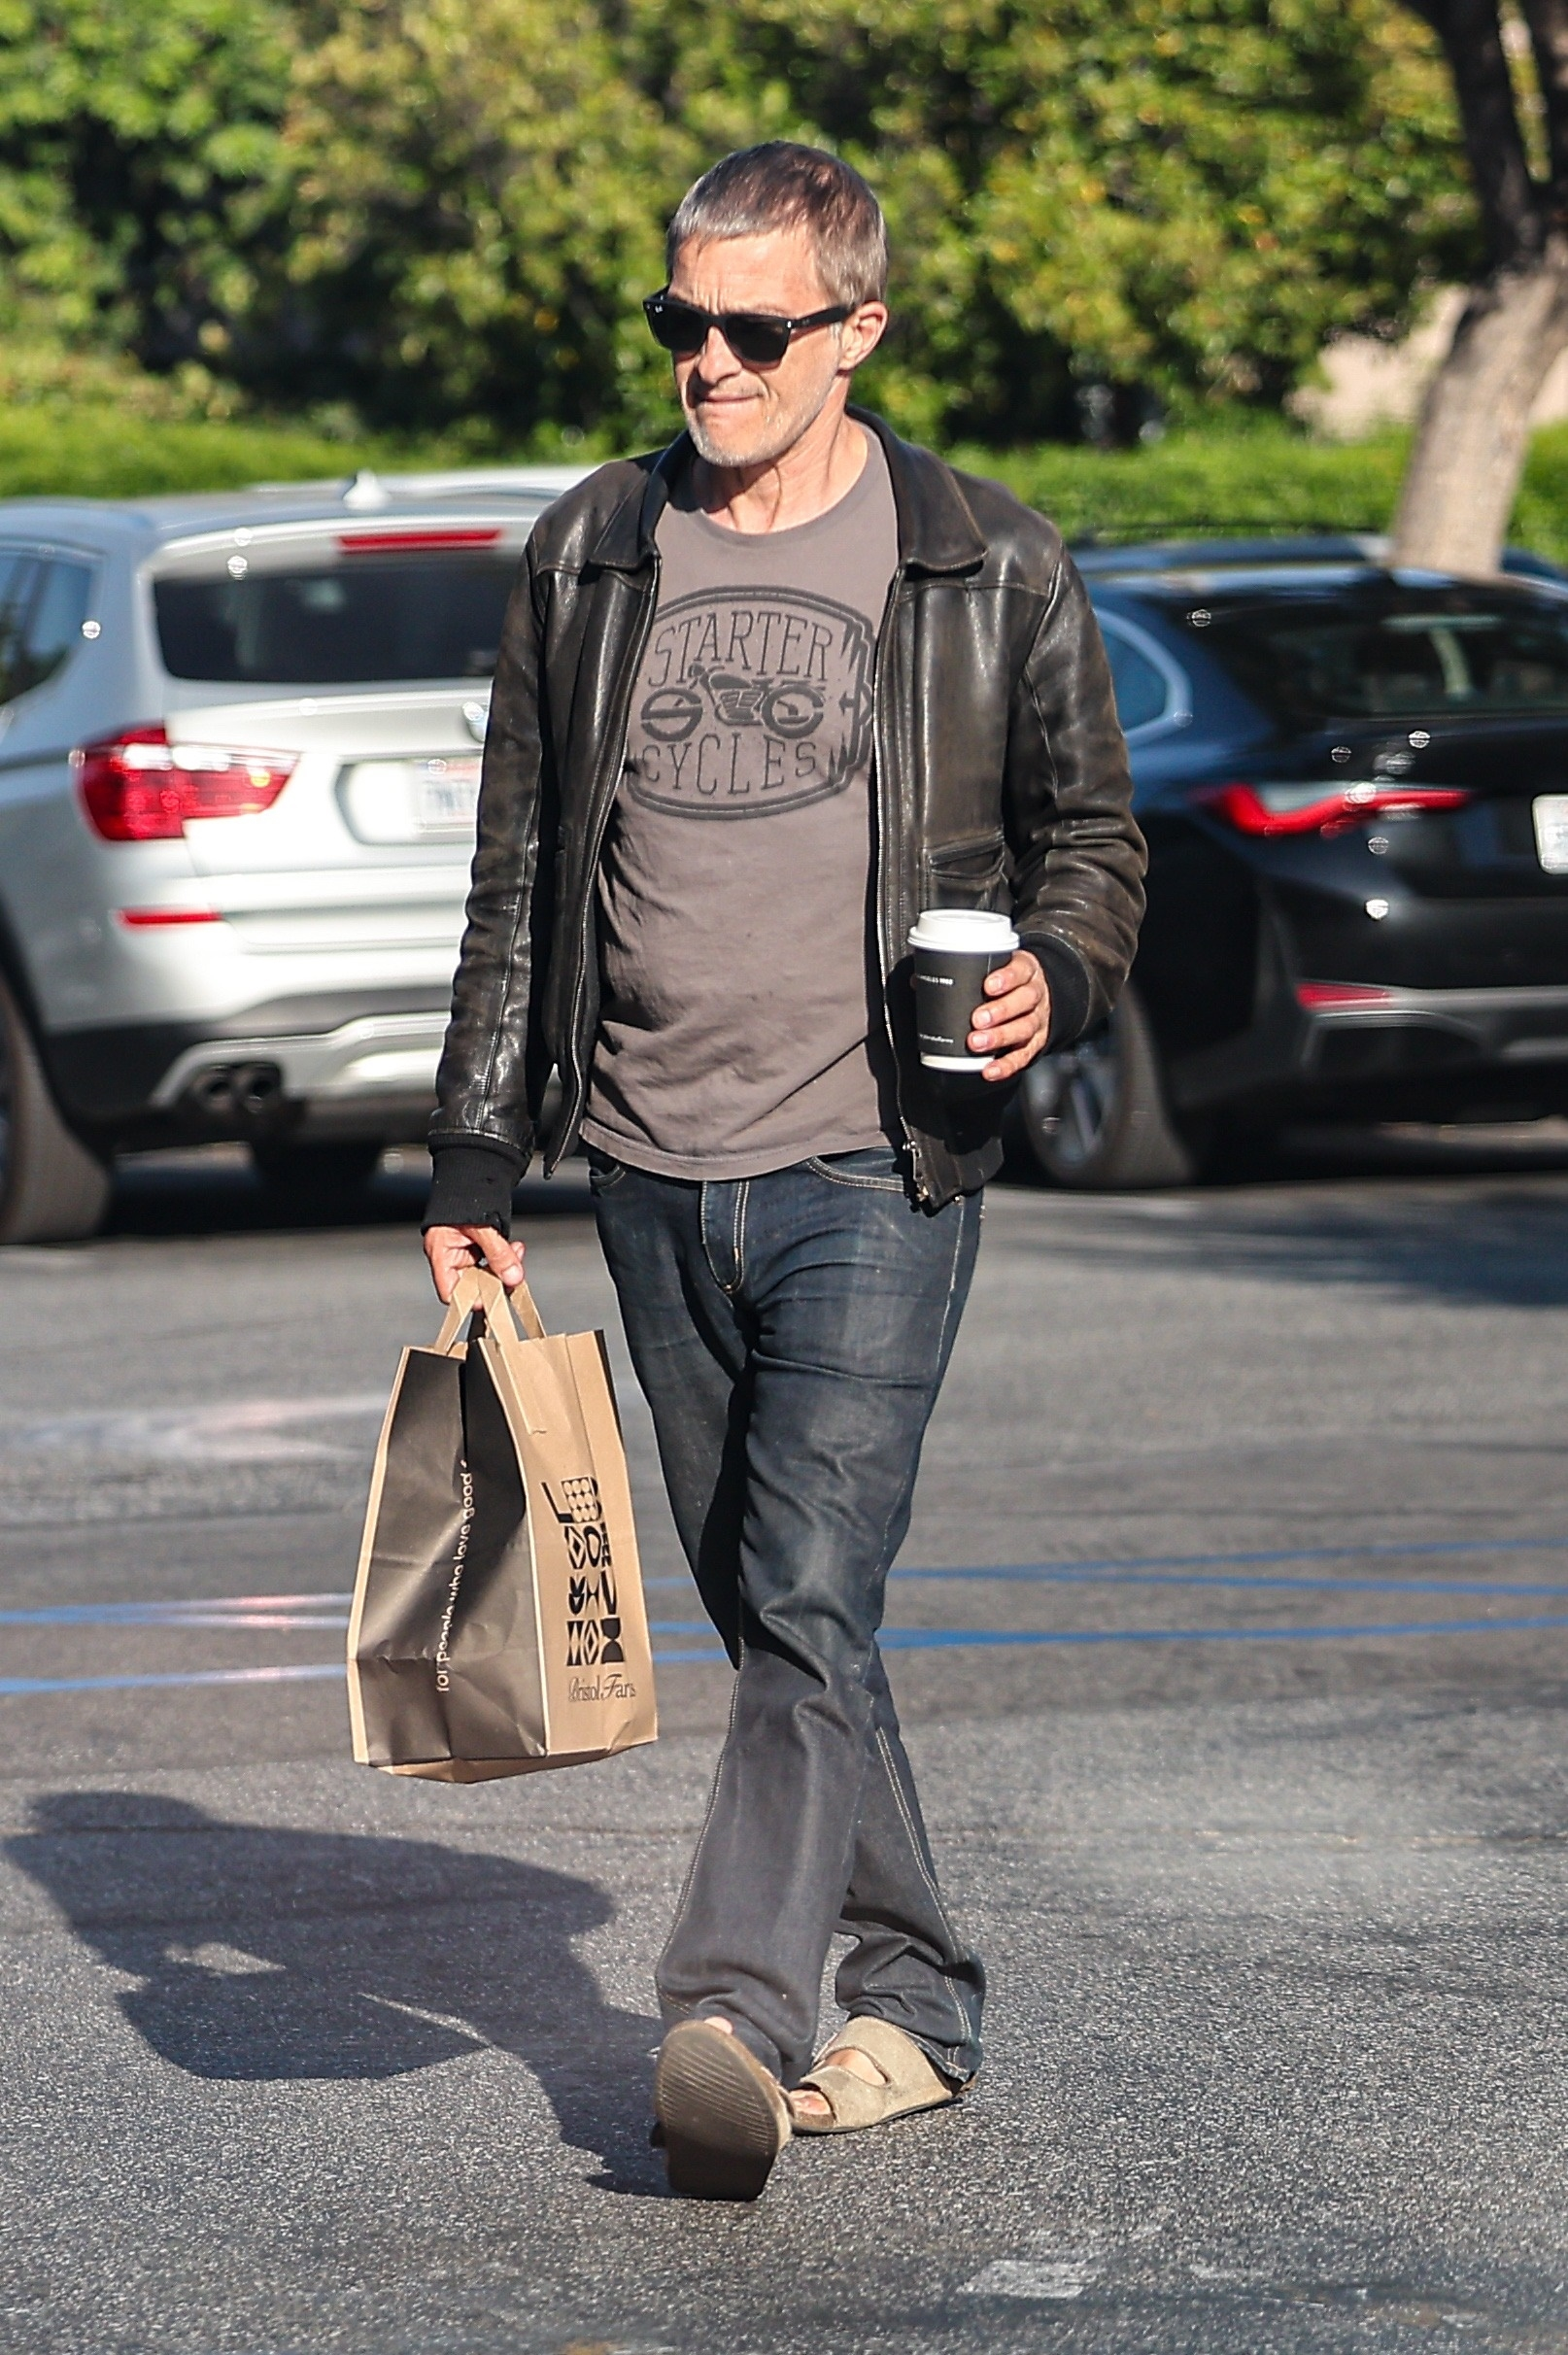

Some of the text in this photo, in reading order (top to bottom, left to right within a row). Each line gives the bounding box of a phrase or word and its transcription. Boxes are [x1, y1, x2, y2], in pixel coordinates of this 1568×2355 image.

[648, 610, 833, 687] STARTER
[641, 733, 817, 795] CYCLES
[460, 1472, 475, 1519] good
[453, 1523, 471, 1560] love
